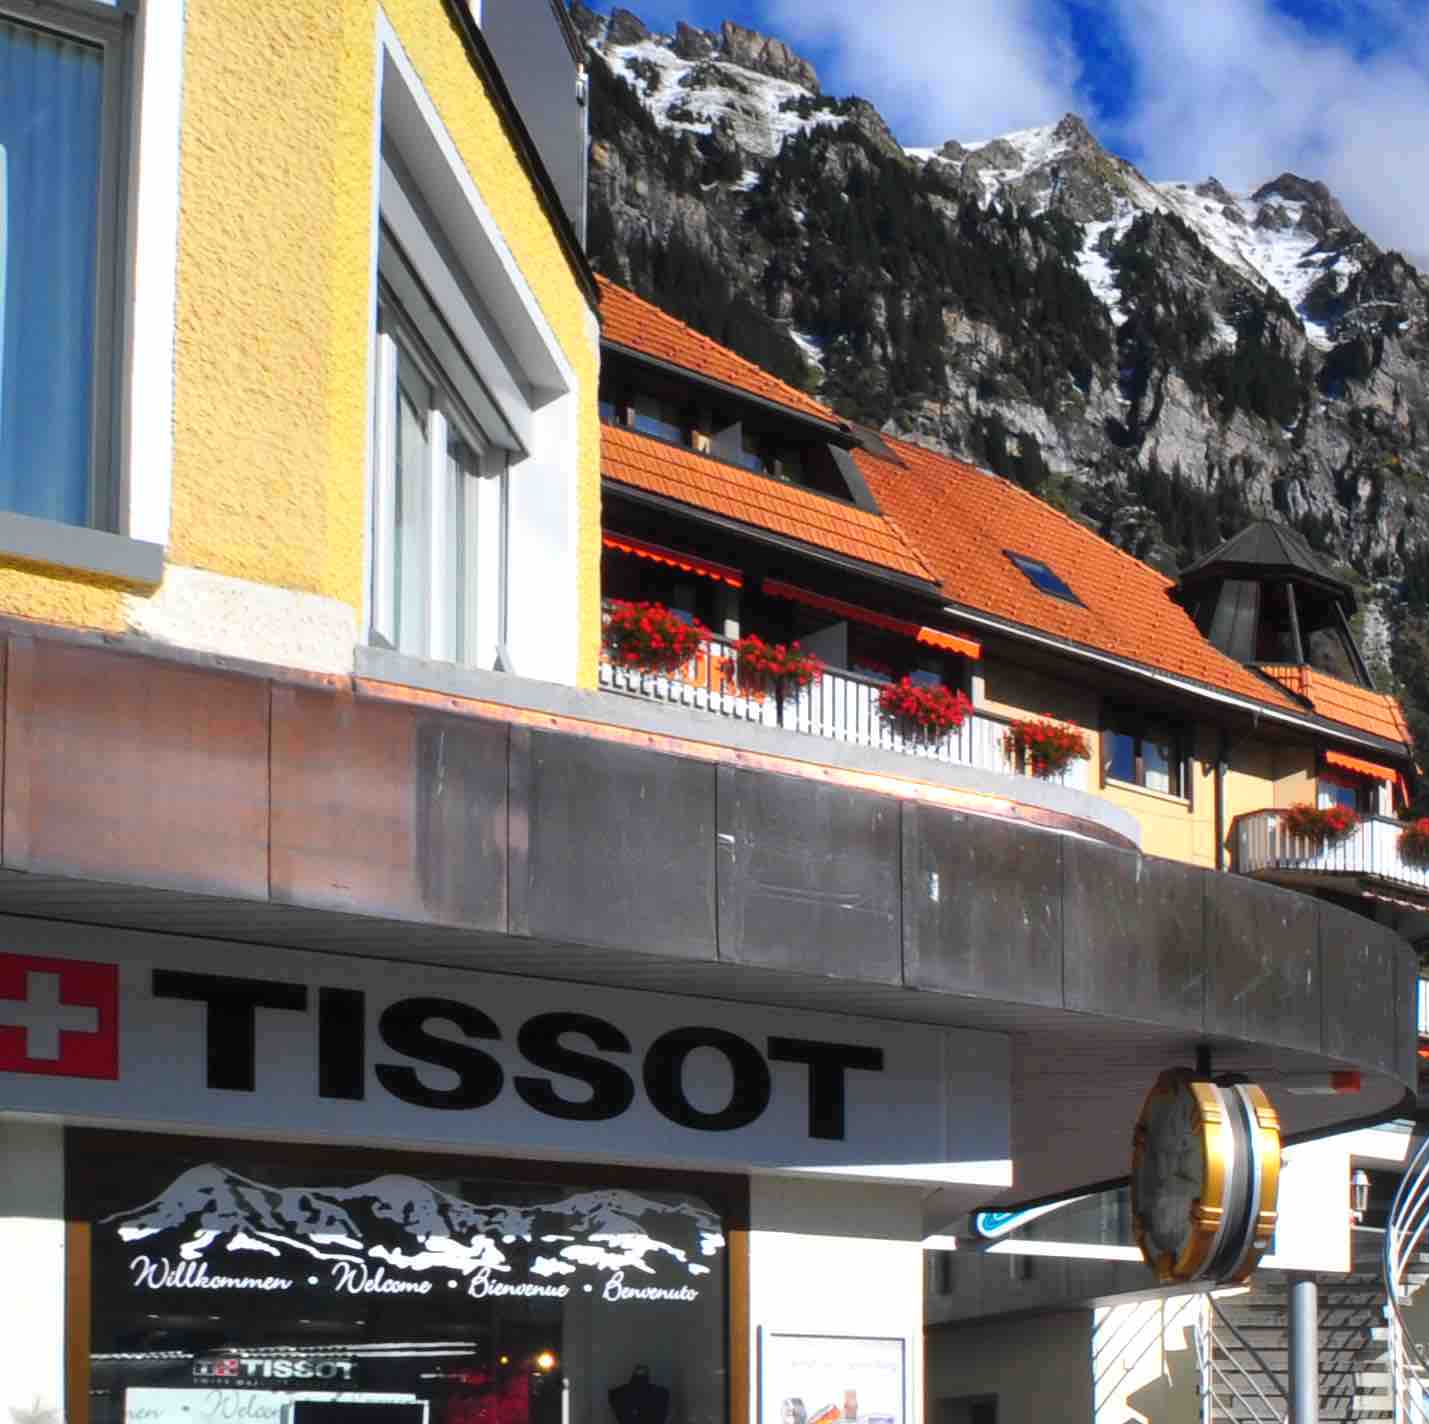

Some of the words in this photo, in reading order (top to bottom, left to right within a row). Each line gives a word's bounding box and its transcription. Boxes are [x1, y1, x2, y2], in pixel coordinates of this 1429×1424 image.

[152, 968, 885, 1142] TISSOT
[130, 1255, 293, 1290] Willkommen
[331, 1261, 433, 1294] Welcome
[468, 1268, 571, 1298] Bienvenue
[602, 1270, 698, 1301] Benvenuto
[240, 1359, 352, 1379] TISSOT
